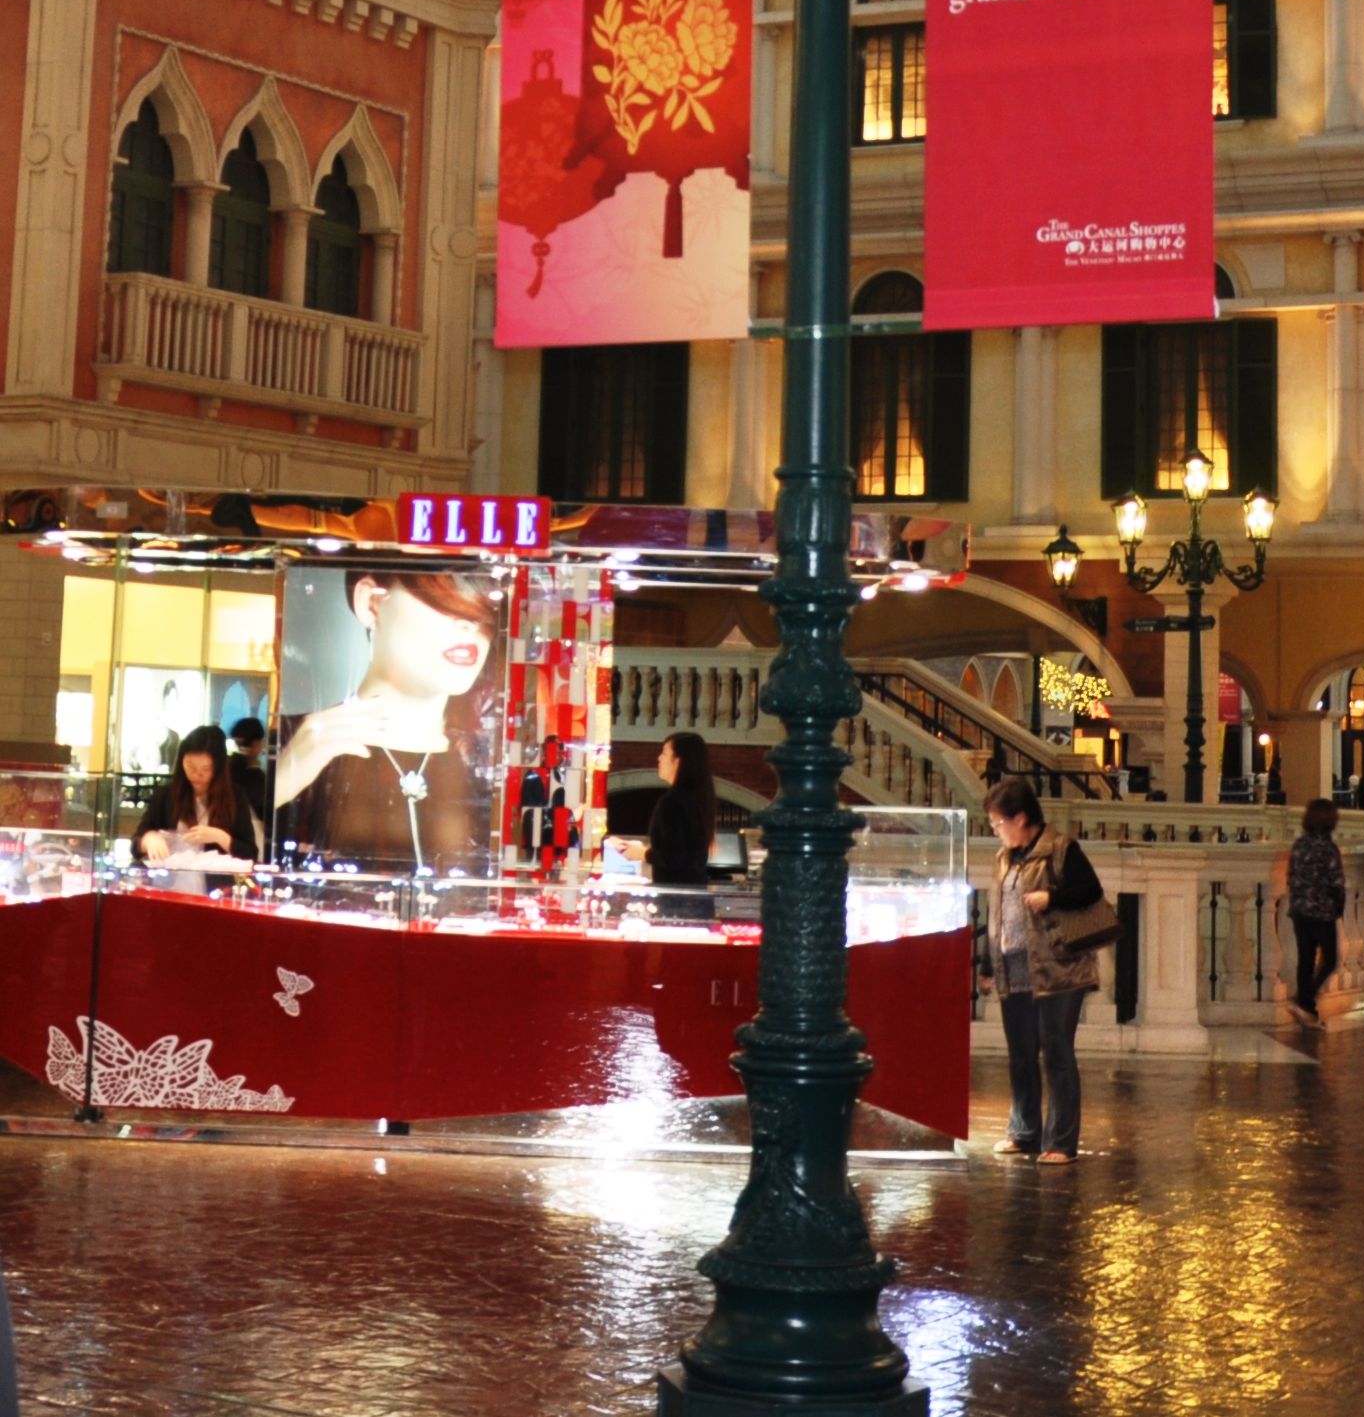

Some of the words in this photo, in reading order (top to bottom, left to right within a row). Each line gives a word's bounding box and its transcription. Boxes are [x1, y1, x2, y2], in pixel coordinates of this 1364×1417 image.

[1036, 226, 1084, 243] GRAND
[1084, 224, 1129, 239] CANAL
[1129, 221, 1186, 236] SHOPPES
[410, 498, 538, 545] ELLE
